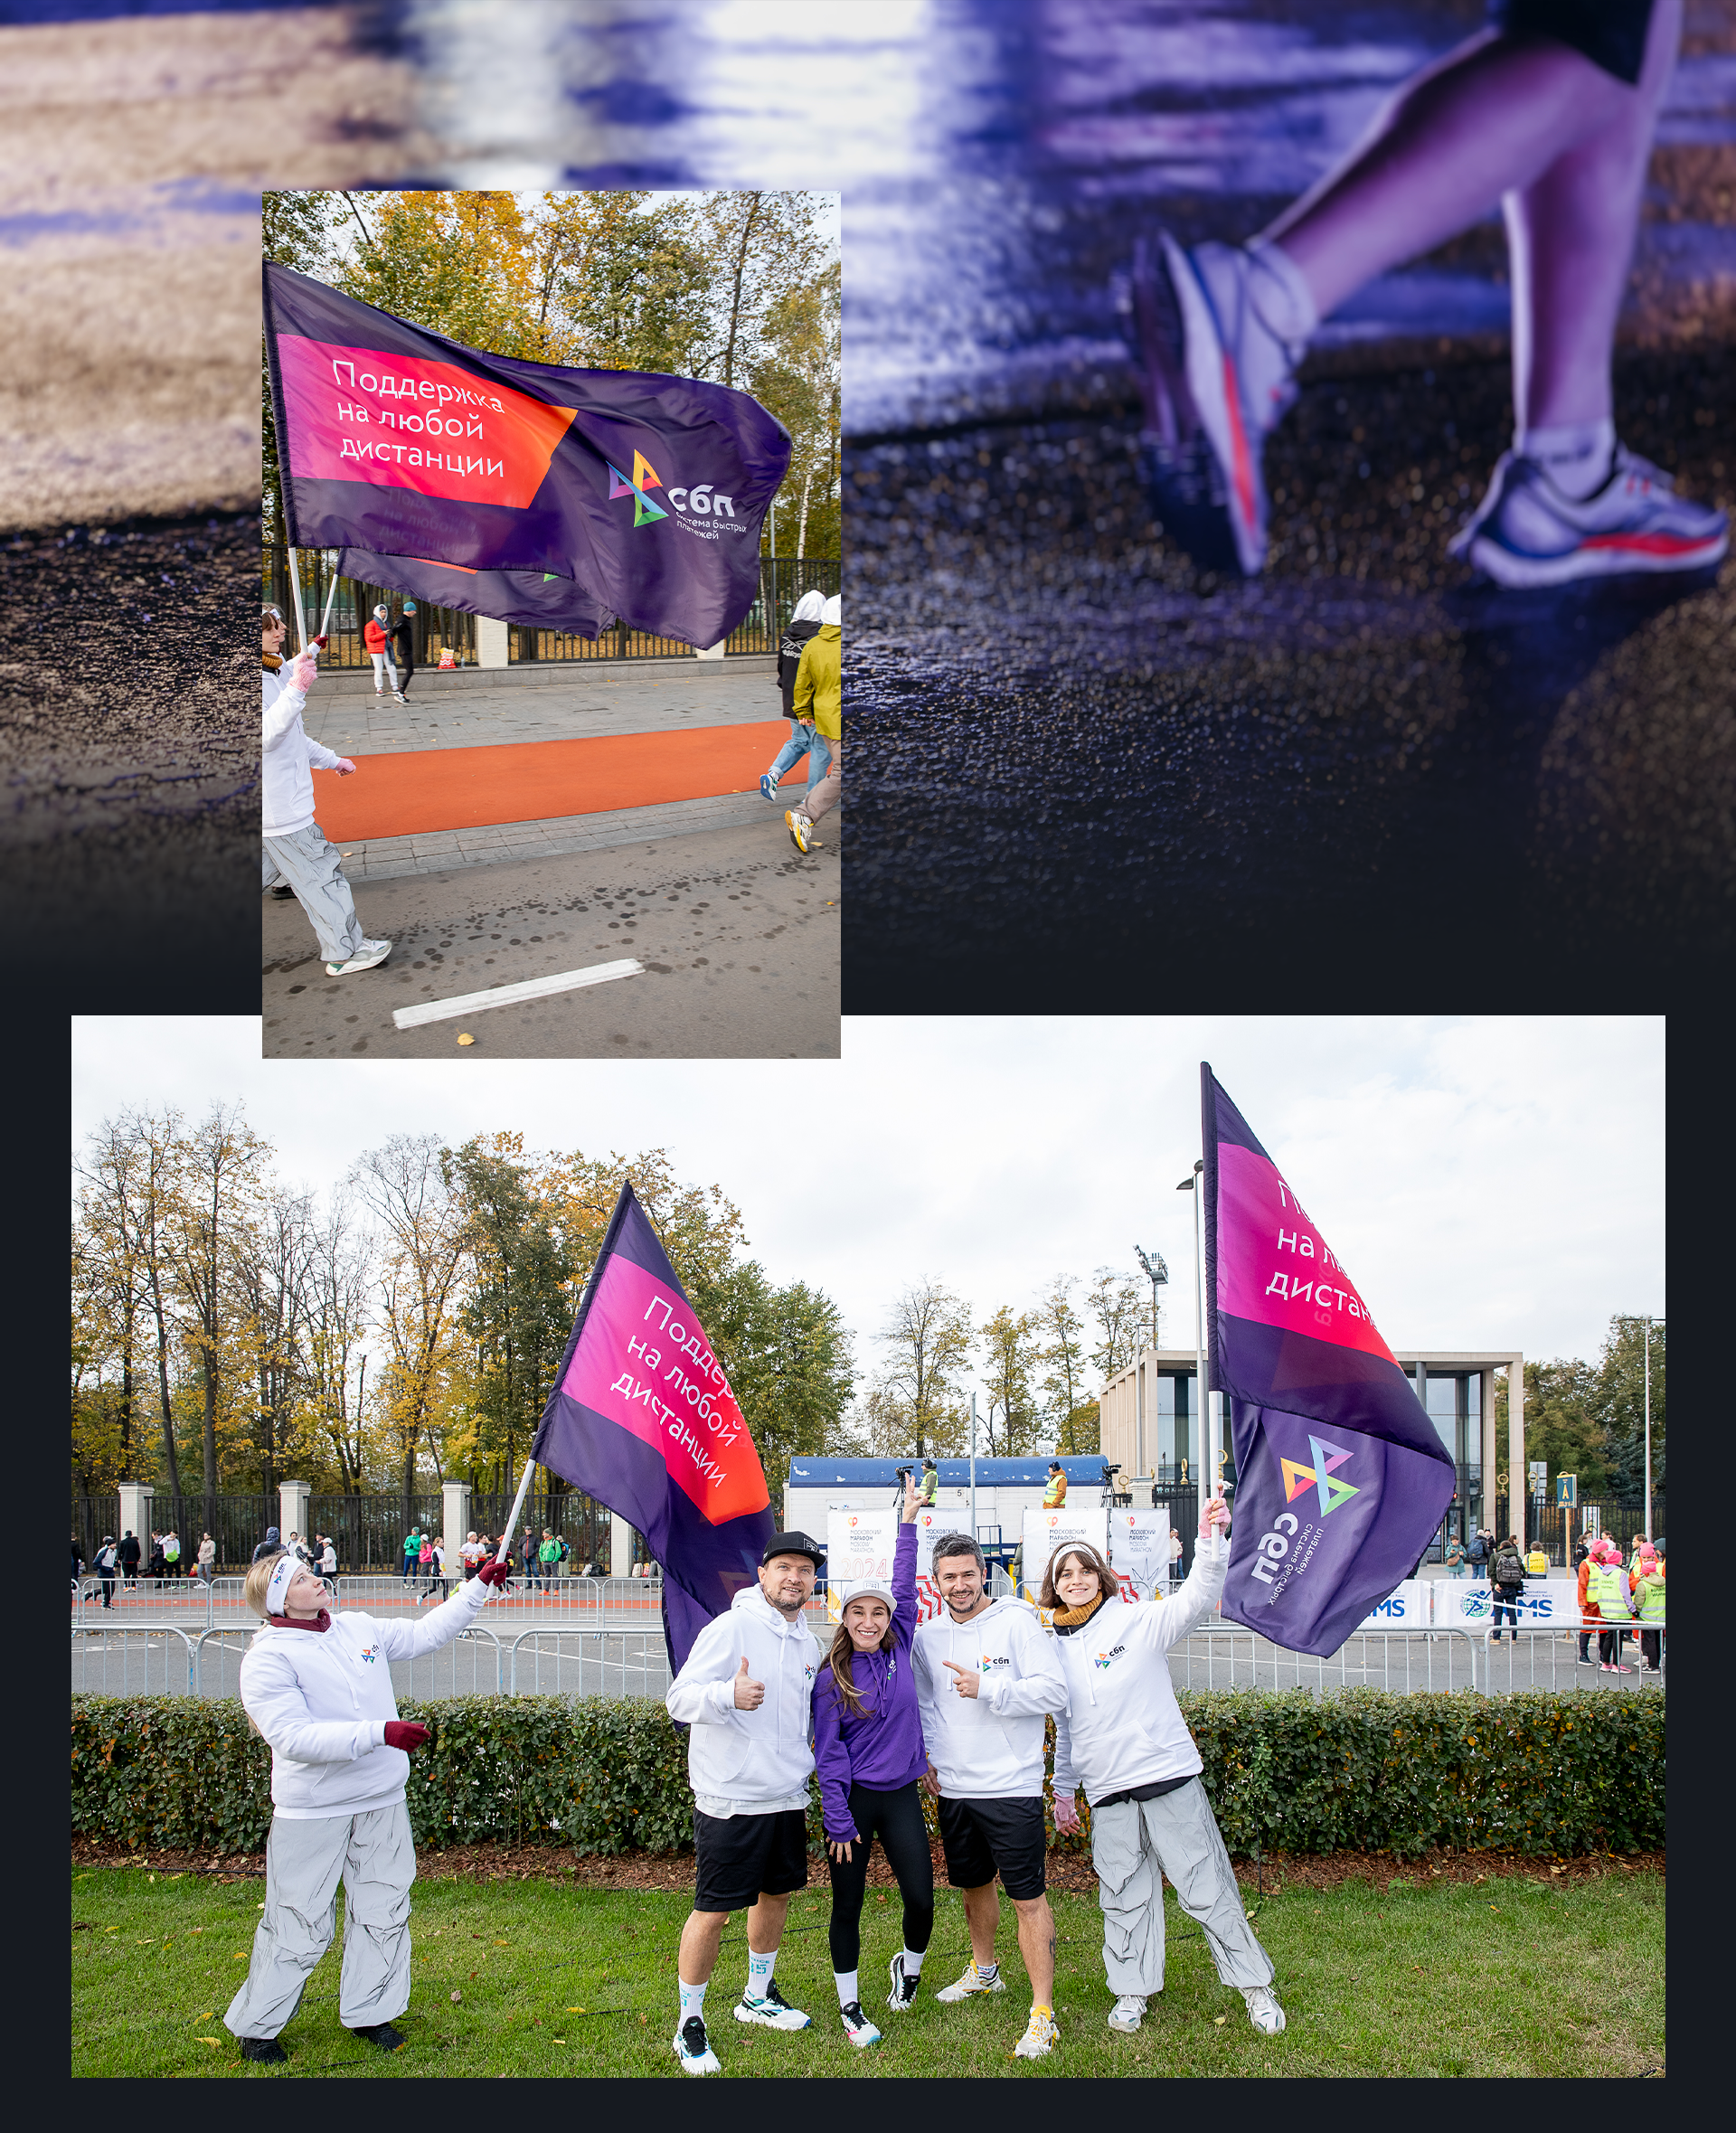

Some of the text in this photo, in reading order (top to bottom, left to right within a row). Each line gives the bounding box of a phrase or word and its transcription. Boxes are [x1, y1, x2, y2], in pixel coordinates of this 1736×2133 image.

[333, 359, 505, 414] Поддержка
[337, 402, 483, 439] на любой
[340, 439, 504, 477] дистанции
[667, 484, 735, 517] сбп
[676, 520, 720, 540] платежей
[712, 519, 748, 533] быстрых
[1277, 1228, 1315, 1259] на
[644, 1295, 739, 1407] Поддер
[627, 1335, 741, 1447] на любой
[609, 1373, 727, 1488] дистанции
[840, 1557, 888, 1581] 2024
[992, 1656, 1010, 1665] сбп
[1109, 1645, 1126, 1657] сбп
